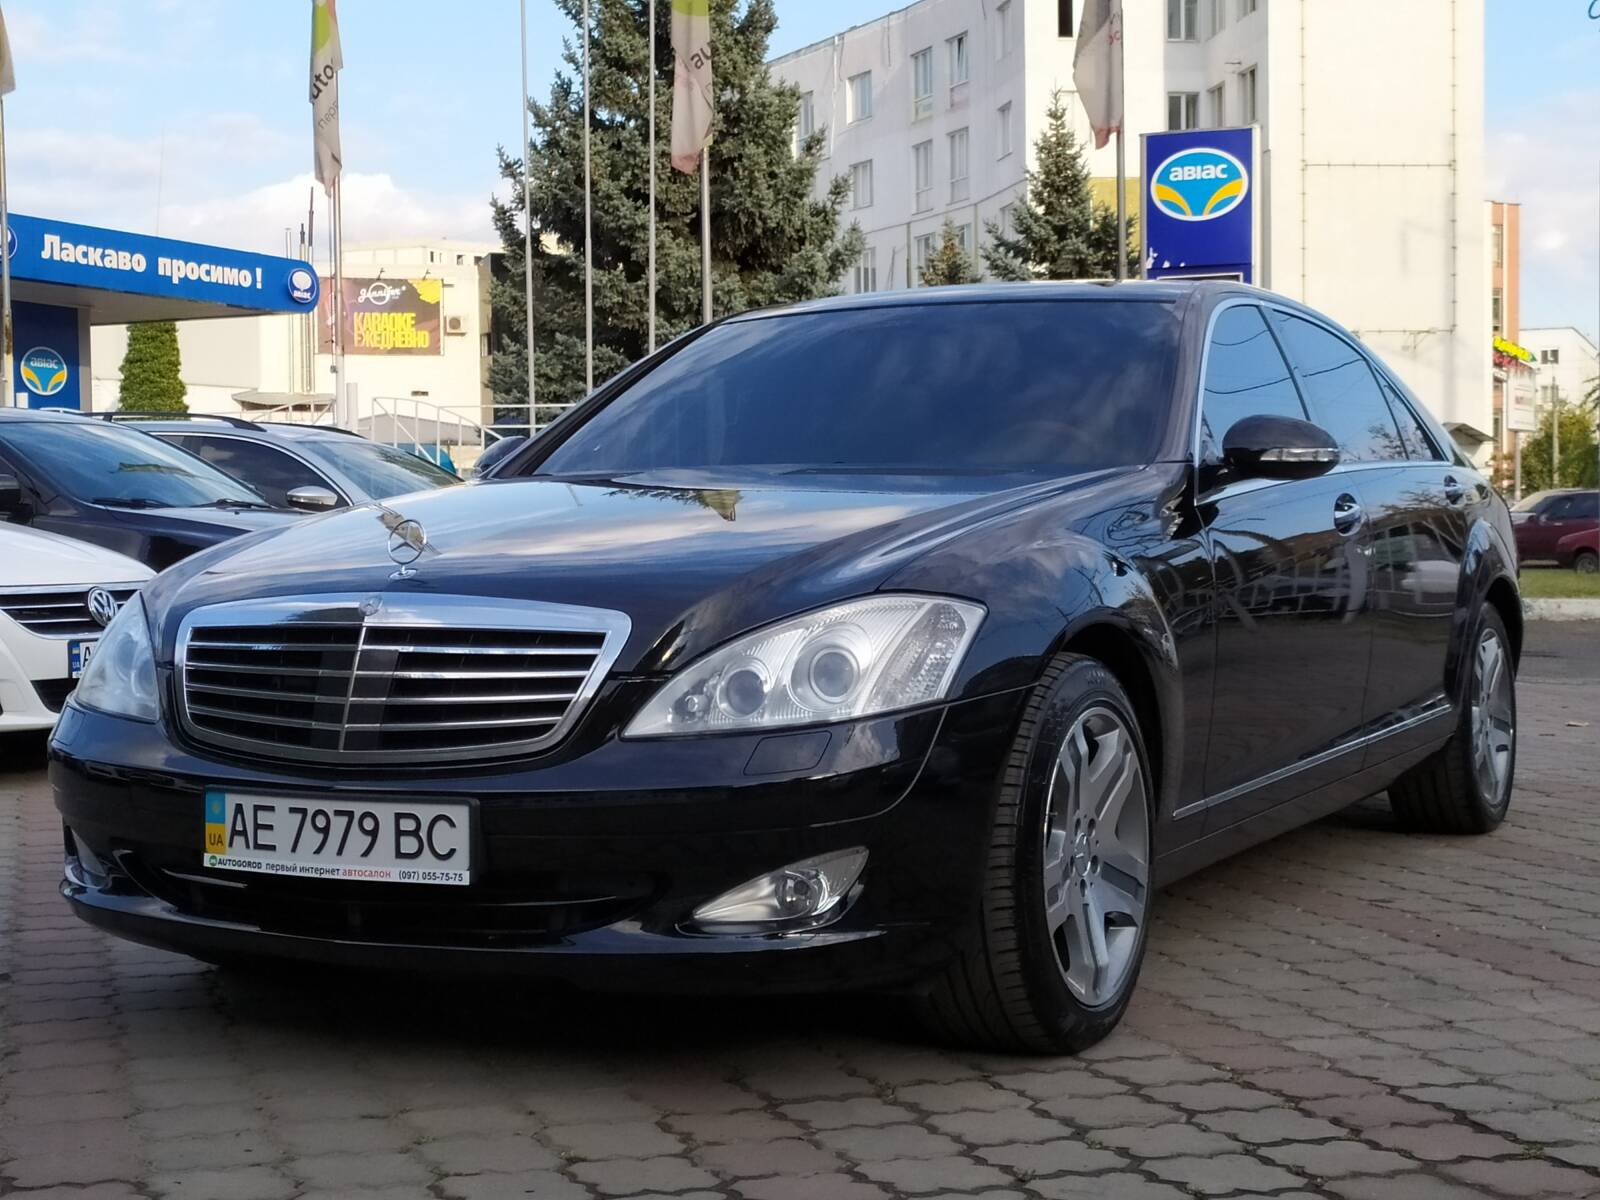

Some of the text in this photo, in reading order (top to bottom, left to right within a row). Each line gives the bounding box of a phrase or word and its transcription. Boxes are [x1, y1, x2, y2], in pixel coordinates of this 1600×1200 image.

[312, 64, 334, 99] uto
[41, 234, 146, 273] Ласкаво
[158, 256, 252, 288] просимо
[208, 832, 224, 846] UA
[228, 803, 457, 861] AE 7979 BC
[265, 863, 464, 882] первый интернет автосалон (097) 055-75-75
